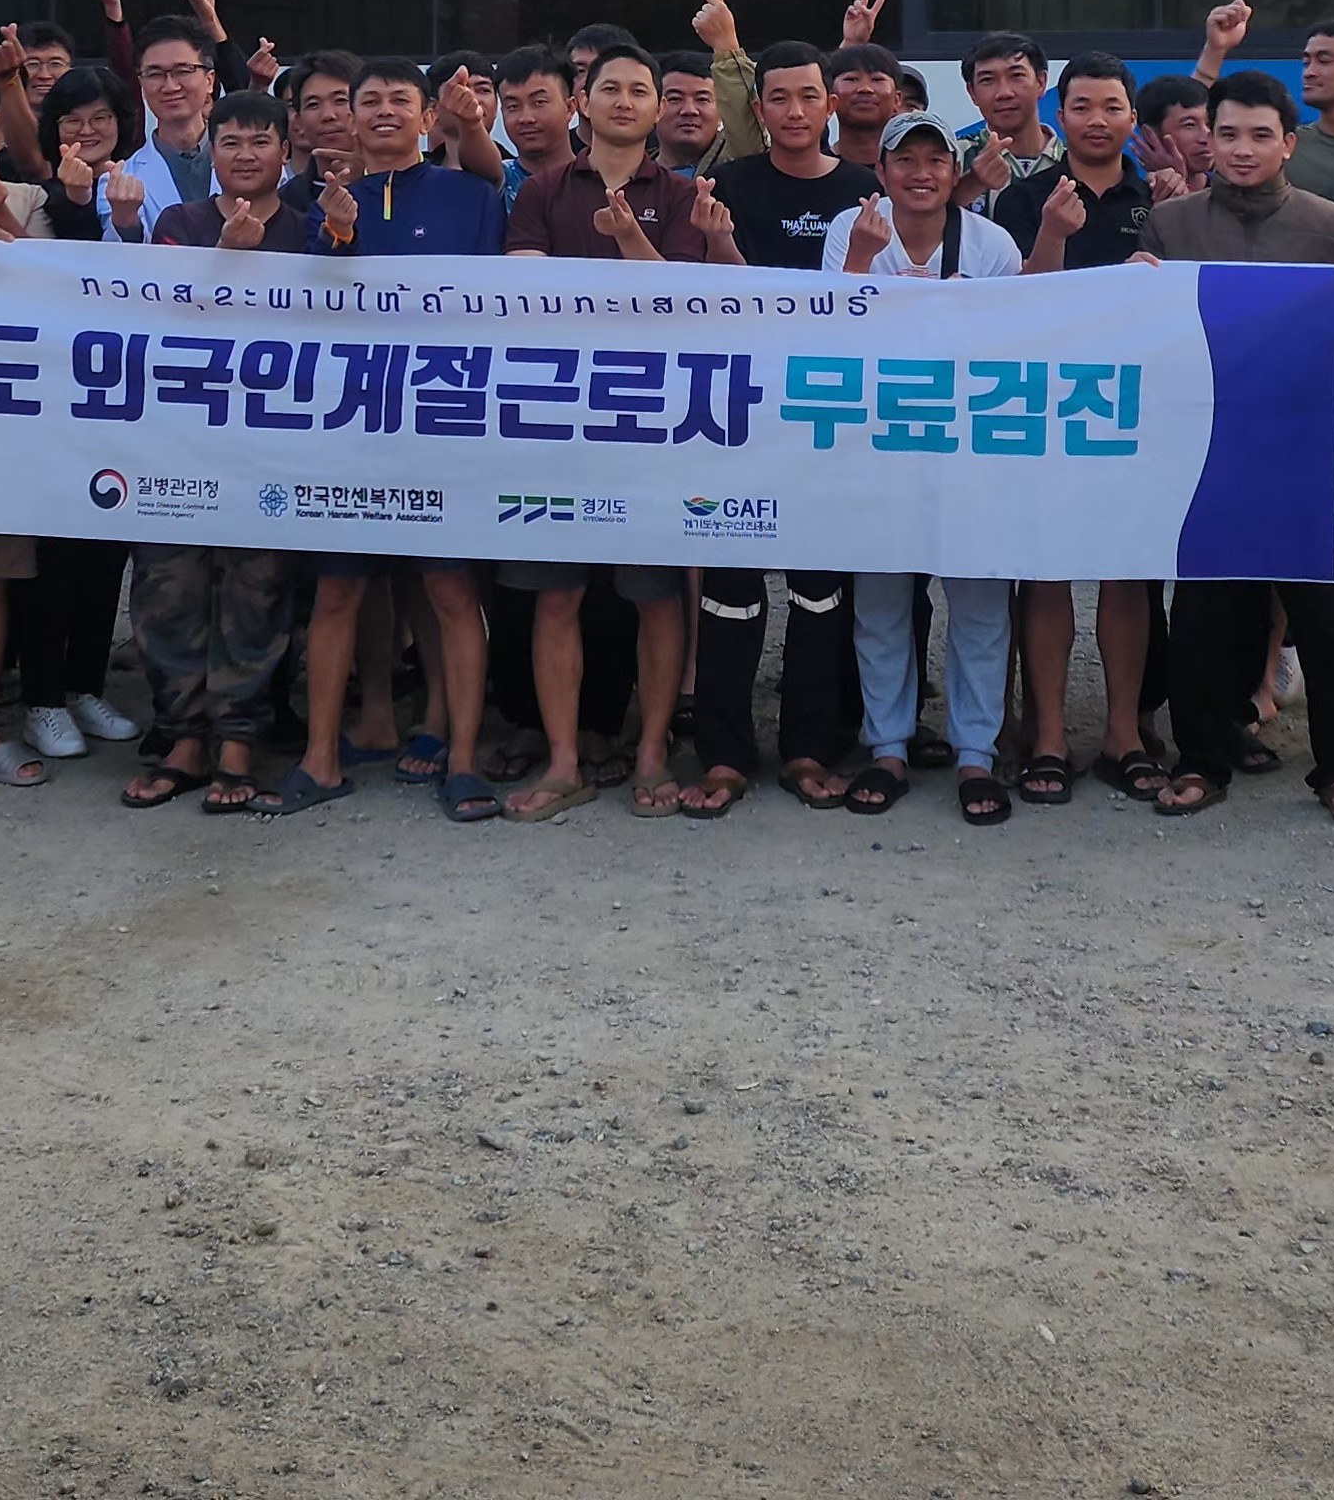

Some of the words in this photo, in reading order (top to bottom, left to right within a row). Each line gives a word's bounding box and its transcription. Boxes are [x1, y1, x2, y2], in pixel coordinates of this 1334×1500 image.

[70, 330, 762, 448] 외국인계절근로자
[779, 356, 1142, 457] 무료검진
[136, 476, 219, 499] 질병관리청
[294, 485, 443, 511] 한국한센복지협회
[295, 508, 324, 519] Korean
[327, 510, 359, 520] Hansen
[362, 511, 393, 521] Welfare
[396, 512, 443, 523] Association
[581, 498, 627, 514] 경기도
[723, 498, 777, 519] GAFI
